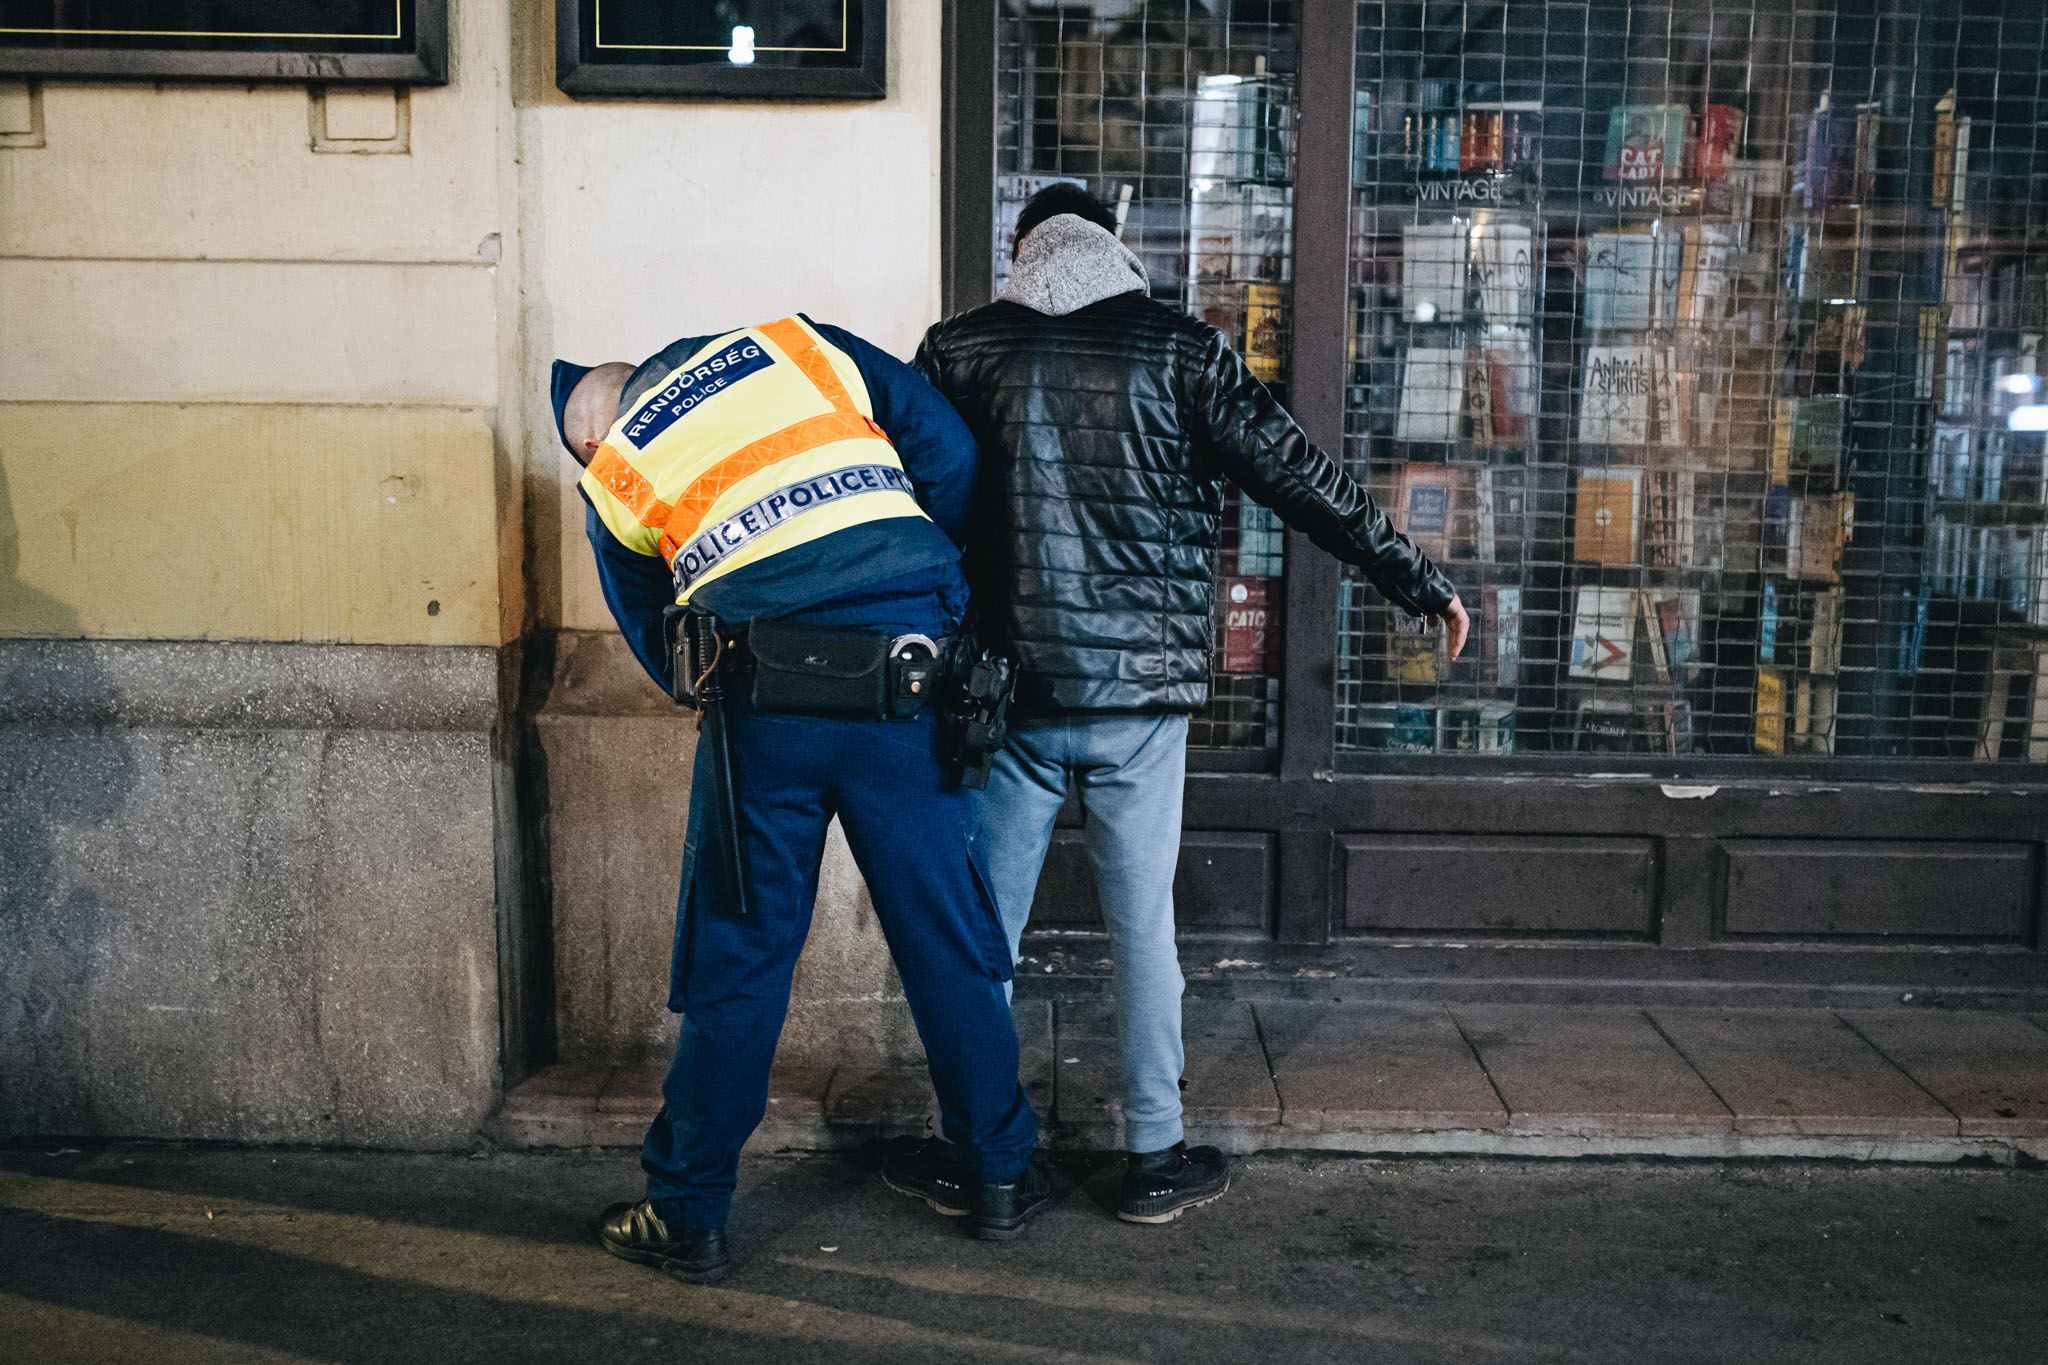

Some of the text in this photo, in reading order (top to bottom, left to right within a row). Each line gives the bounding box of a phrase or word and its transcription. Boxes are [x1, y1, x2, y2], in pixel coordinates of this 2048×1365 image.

[1620, 148, 1661, 165] CAT
[1419, 178, 1503, 200] VINTAGE
[1589, 353, 1648, 388] ANIMAL
[628, 345, 760, 437] RENDŐRSÉG
[672, 377, 728, 416] POLICE
[769, 469, 878, 519] POLICE
[1228, 610, 1266, 627] CATC
